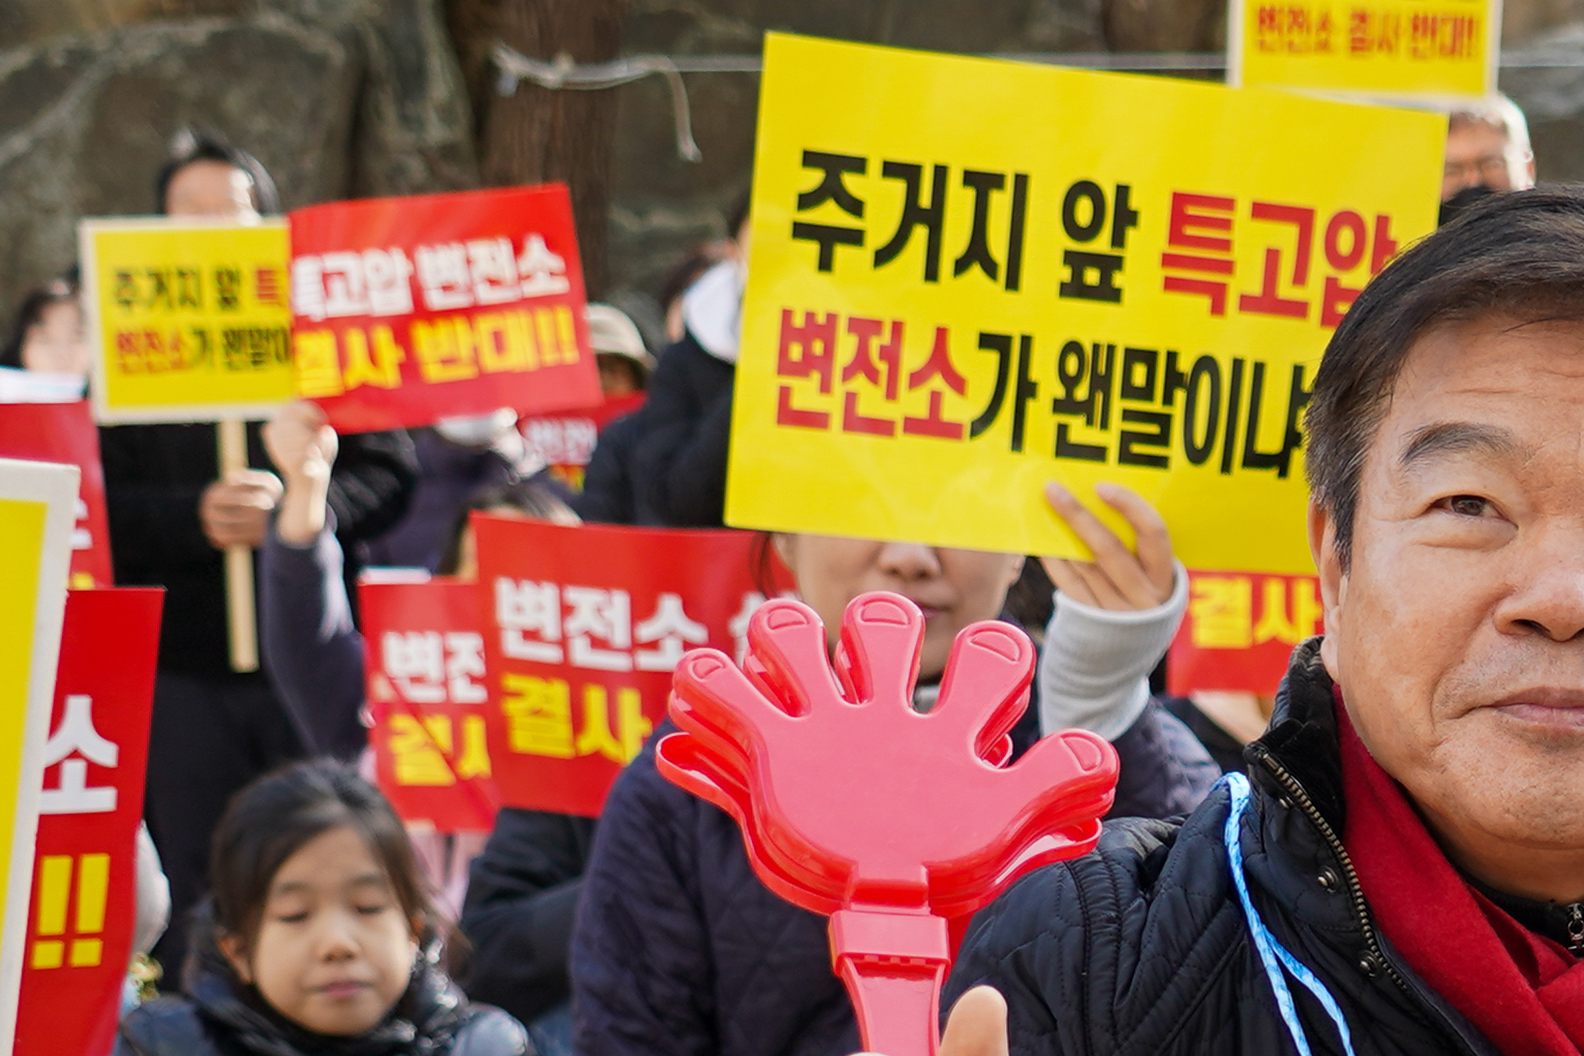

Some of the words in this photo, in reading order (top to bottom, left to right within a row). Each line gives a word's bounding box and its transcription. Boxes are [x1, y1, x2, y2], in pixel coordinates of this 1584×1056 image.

[292, 247, 415, 320] 특고압
[414, 233, 570, 311] 변전소
[791, 149, 1029, 292] 주거지
[1059, 180, 1138, 303] 앞
[1161, 192, 1396, 330] 특고압
[294, 324, 406, 398] 결사
[410, 304, 580, 384] 반대!!
[776, 308, 1036, 453] 변전소가
[1053, 339, 1312, 480] 왠말이냐
[494, 576, 708, 672] 변전소
[1190, 577, 1323, 649] 결사
[40, 694, 118, 815] 소
[503, 672, 653, 766] 결사
[31, 853, 110, 970] !!
